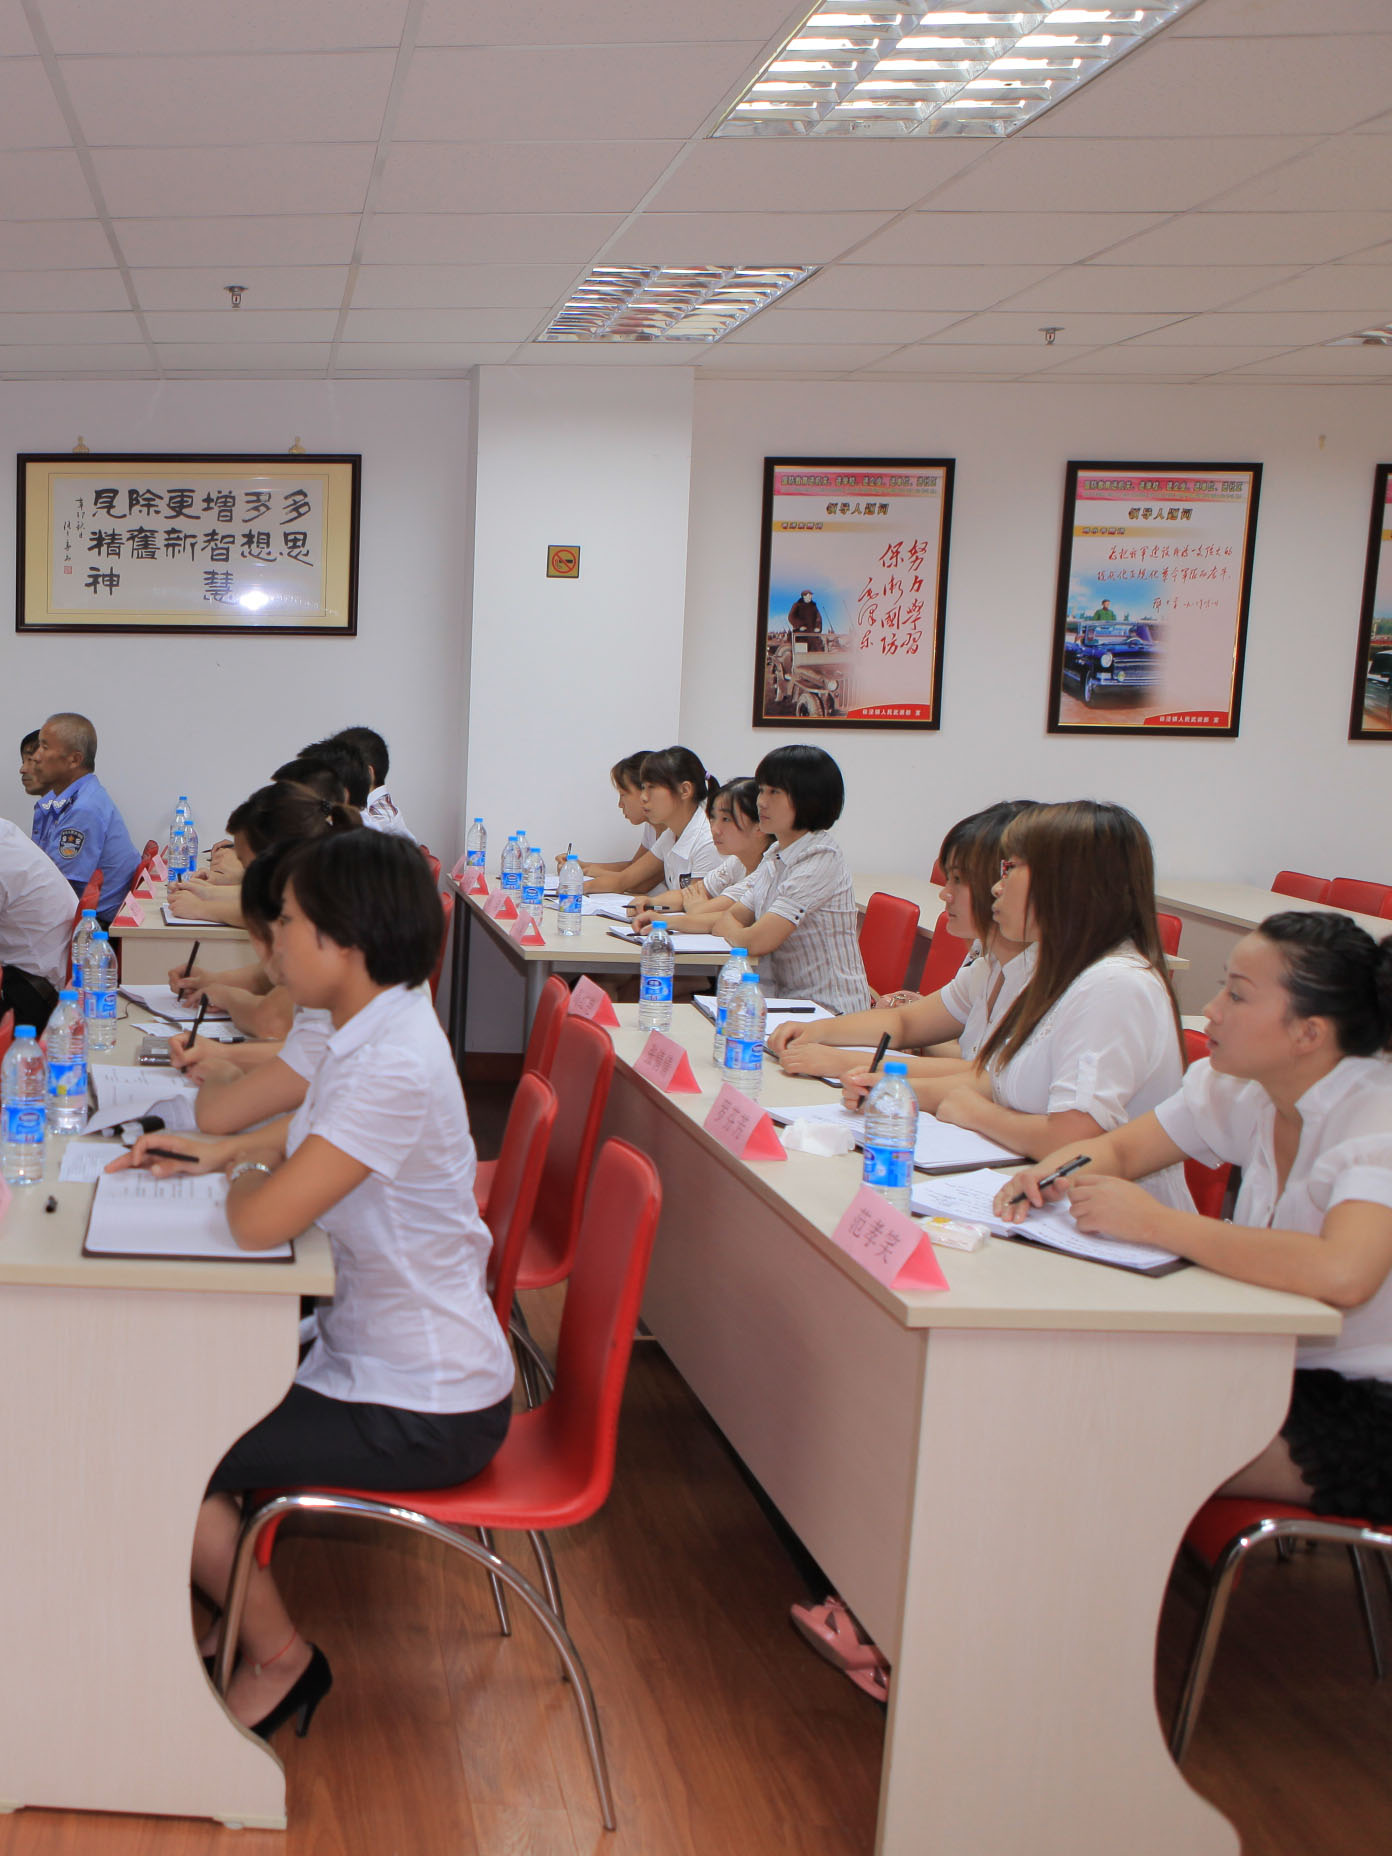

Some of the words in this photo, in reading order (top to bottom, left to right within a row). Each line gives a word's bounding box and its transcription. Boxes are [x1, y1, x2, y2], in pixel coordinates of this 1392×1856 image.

[826, 502, 890, 515] 领导人题词
[1128, 507, 1193, 520] 领导人题词
[201, 489, 237, 605] 增智慧
